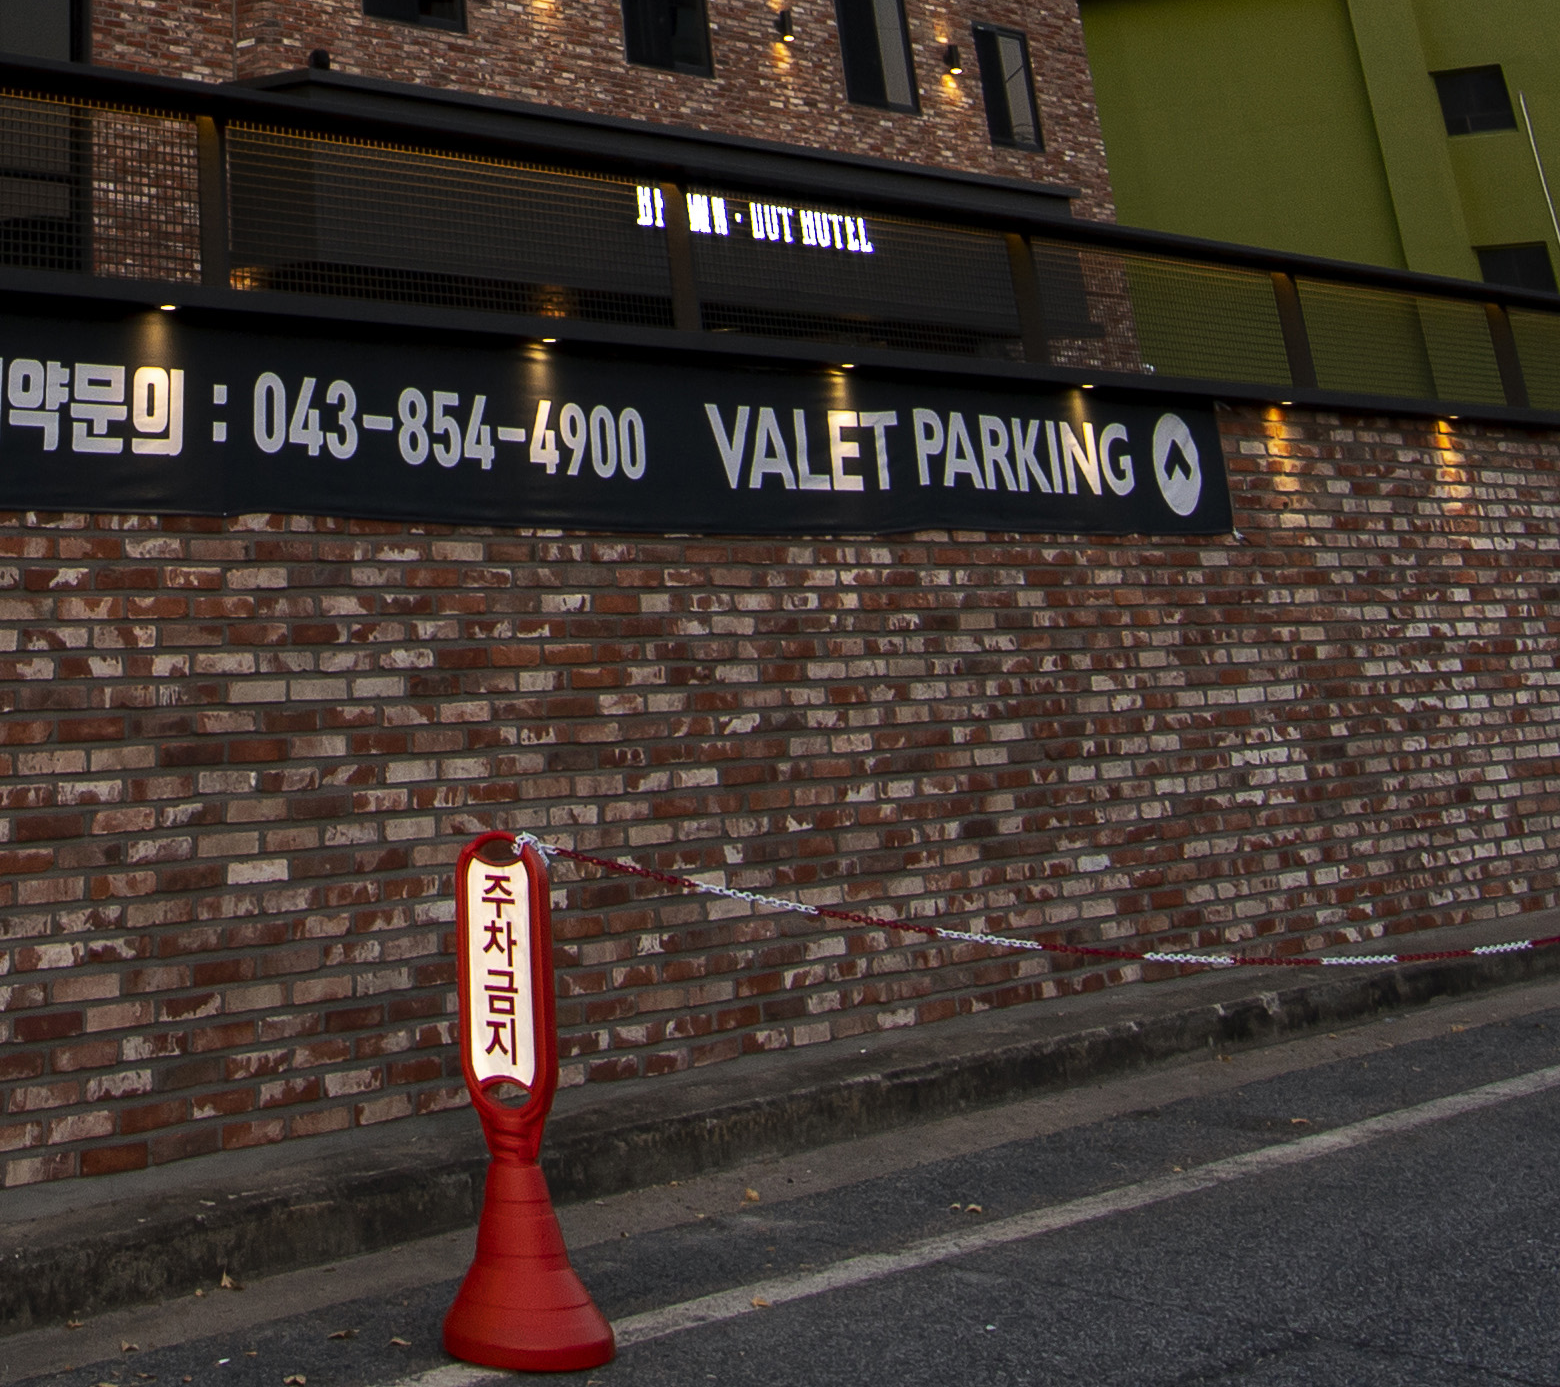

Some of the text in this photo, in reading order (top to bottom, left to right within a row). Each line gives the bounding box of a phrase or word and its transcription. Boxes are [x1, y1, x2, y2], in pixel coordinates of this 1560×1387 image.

[799, 209, 875, 253] HOTEL
[253, 370, 646, 479] 043-854-4900
[703, 403, 898, 492] VALET
[913, 408, 1134, 497] PARKING
[481, 874, 520, 1067] 주차금지
